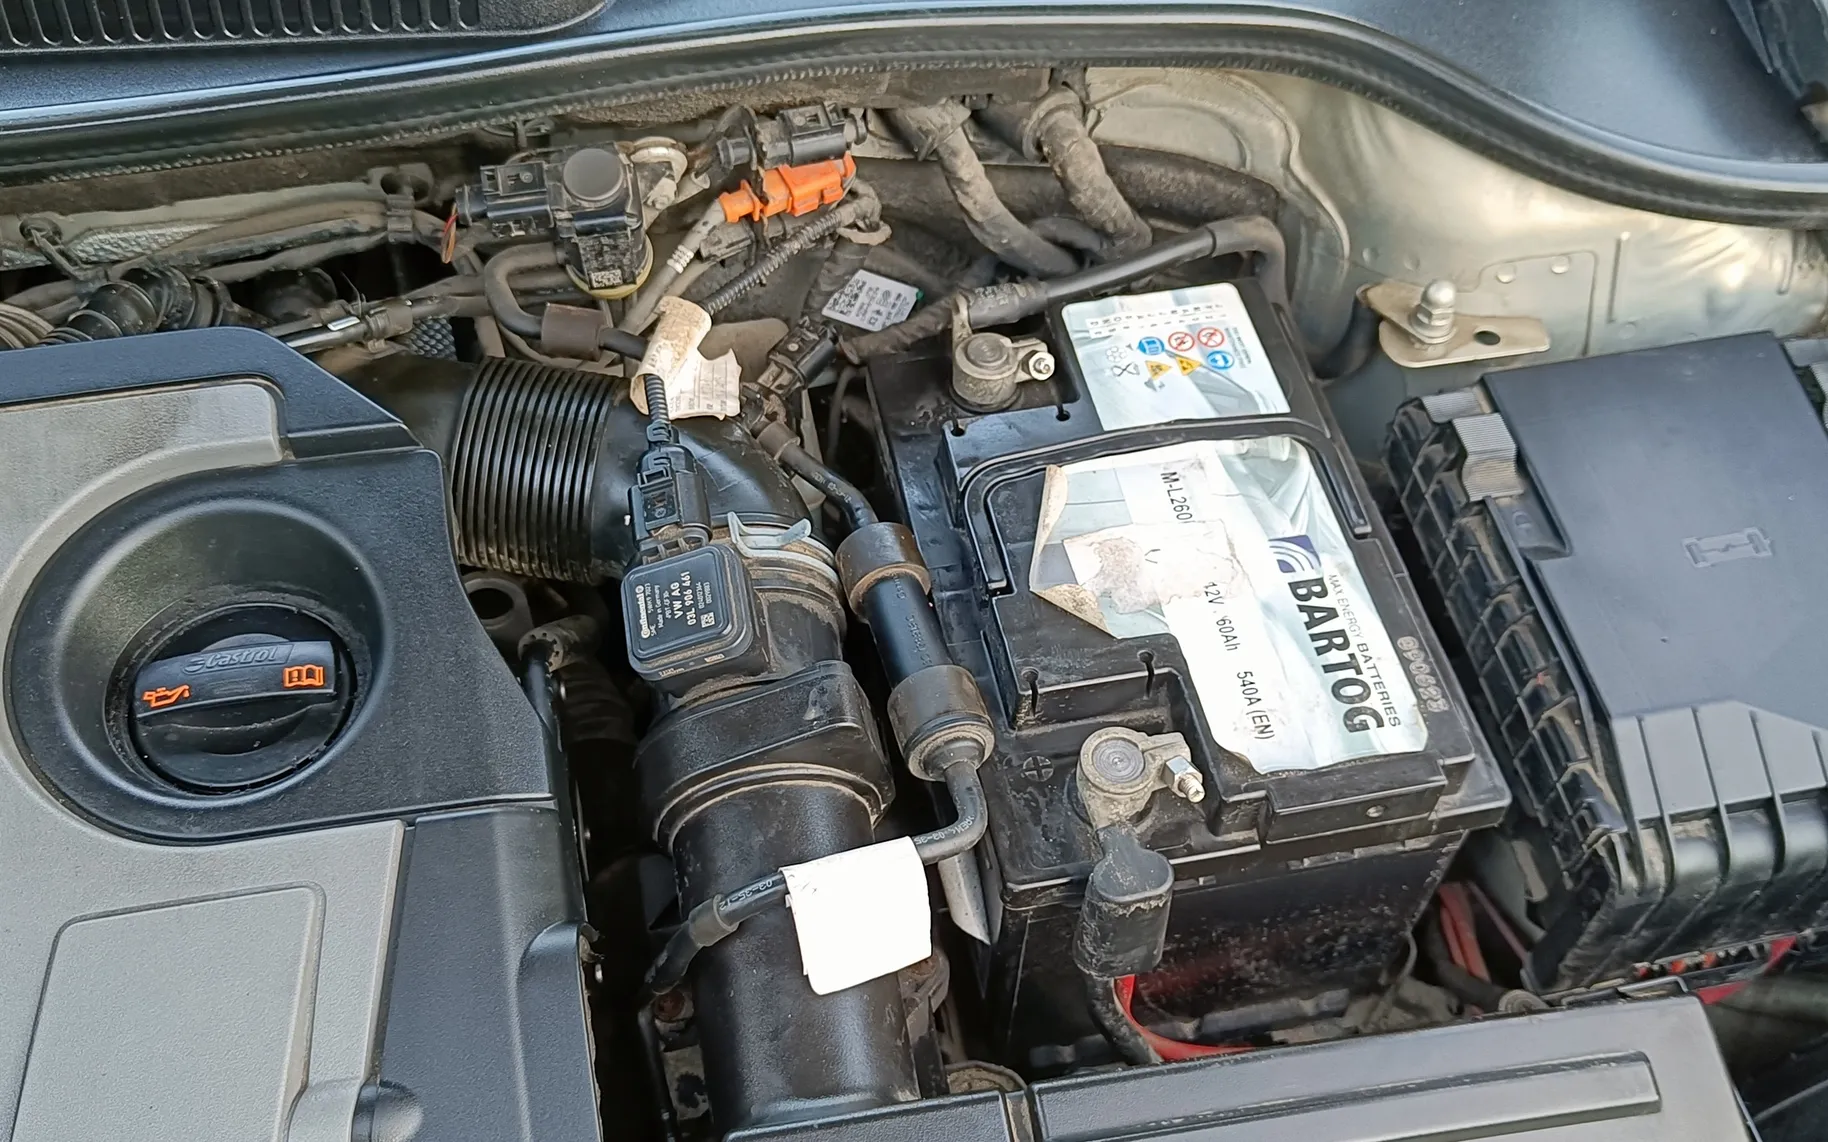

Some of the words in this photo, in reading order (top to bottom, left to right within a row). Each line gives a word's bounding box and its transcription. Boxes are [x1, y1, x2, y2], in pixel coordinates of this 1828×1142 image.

[670, 582, 681, 597] AG
[680, 570, 691, 588] 461
[683, 588, 694, 607] 906
[1203, 581, 1224, 605] 12V
[672, 600, 684, 619] VW
[686, 607, 697, 626] 03L
[1216, 616, 1241, 651] 60Ah
[205, 646, 279, 670] Castrol
[1287, 576, 1385, 733] BARTOG
[1328, 574, 1344, 596] MAX
[1337, 596, 1365, 639] ENERGY
[1356, 642, 1402, 728] BATTERIES
[1236, 670, 1262, 706] 540A
[1246, 709, 1275, 740] (EN)
